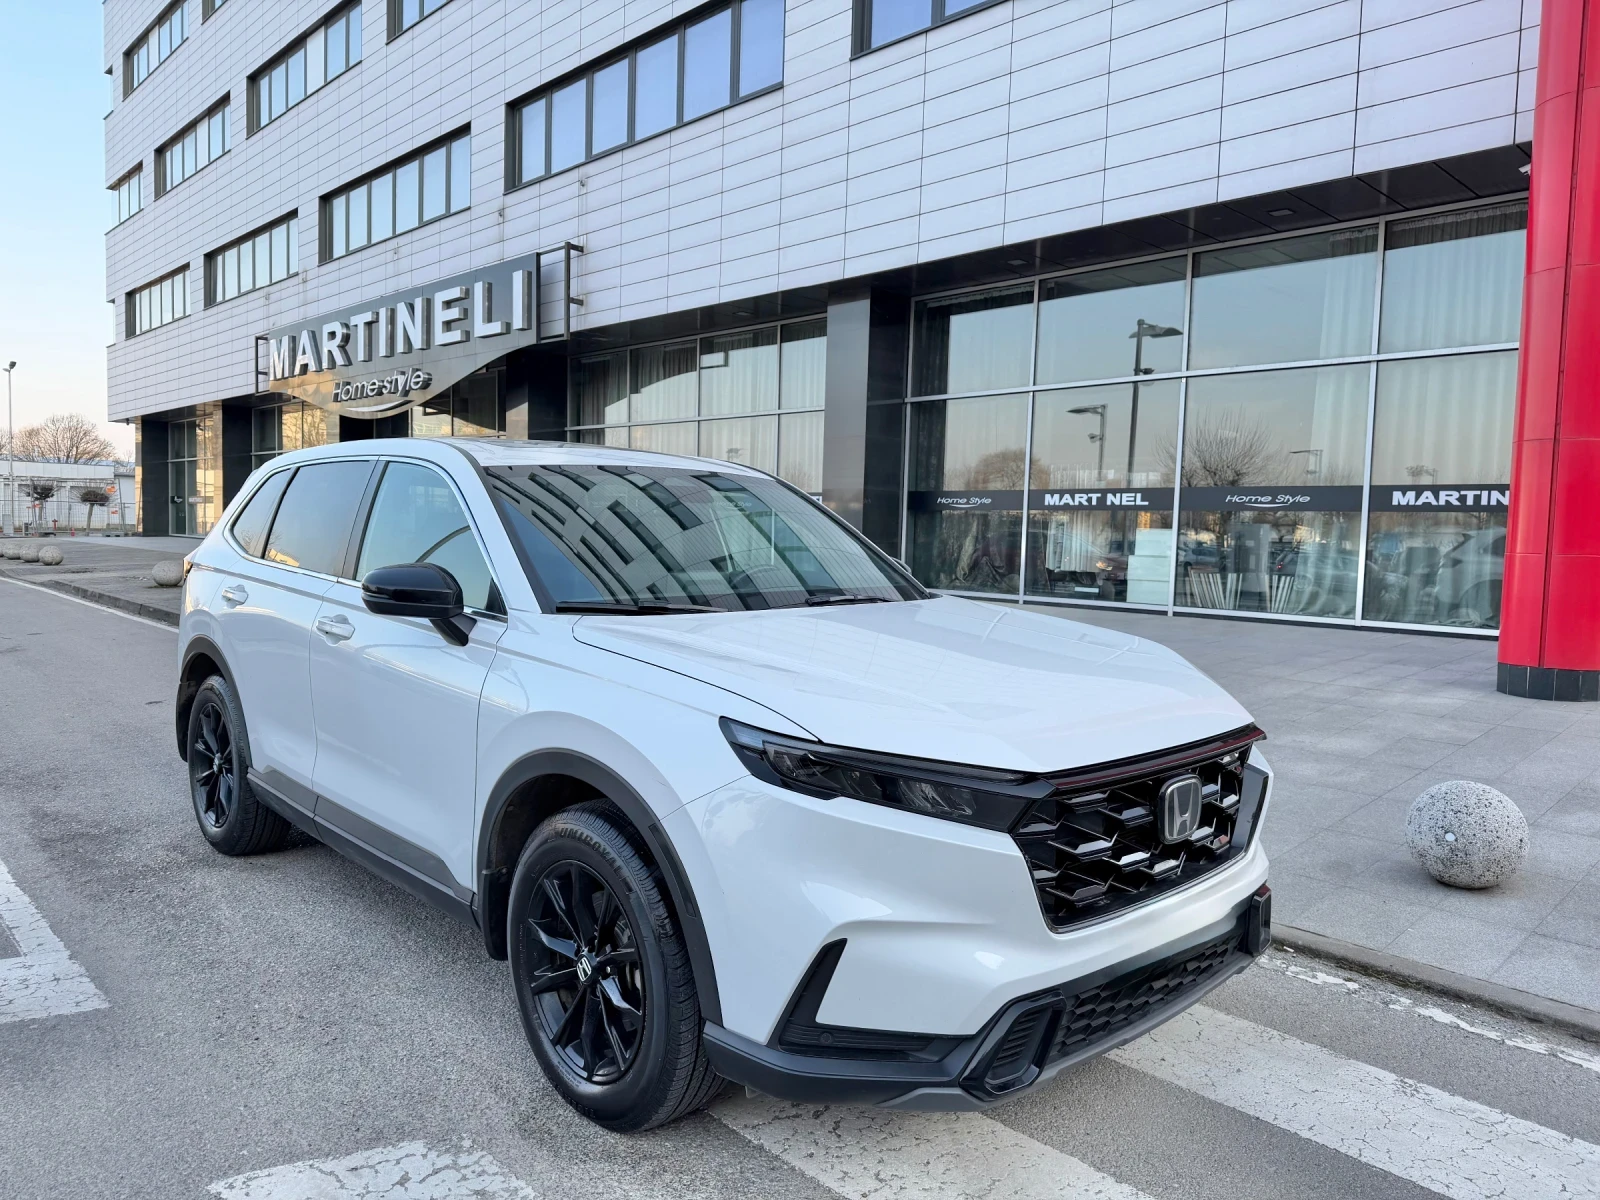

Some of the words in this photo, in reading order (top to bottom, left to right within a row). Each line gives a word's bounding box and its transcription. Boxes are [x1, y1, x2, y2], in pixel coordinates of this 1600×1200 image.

[269, 269, 532, 380] MARTINELI
[936, 496, 967, 504] Home
[968, 496, 992, 505] Style
[1225, 494, 1272, 503] Home
[1275, 494, 1311, 505] Style
